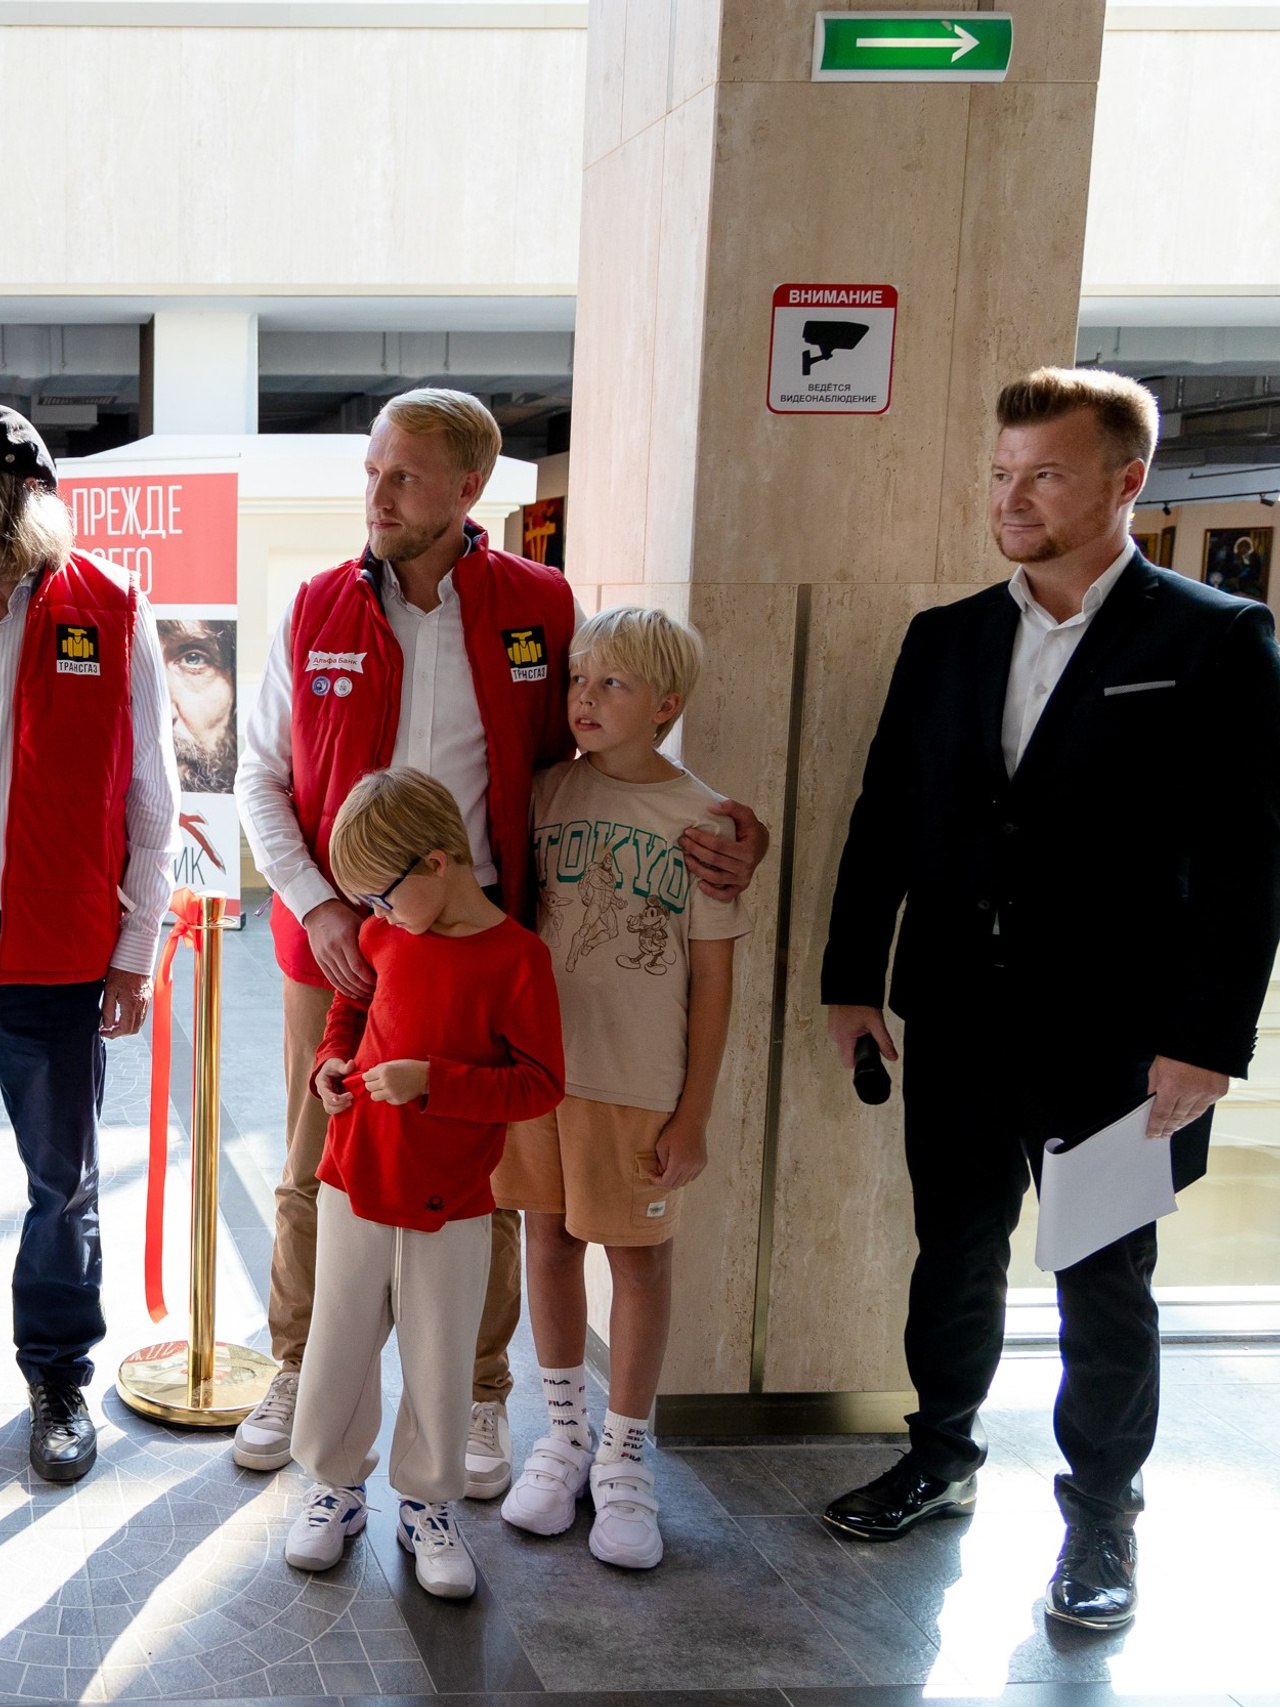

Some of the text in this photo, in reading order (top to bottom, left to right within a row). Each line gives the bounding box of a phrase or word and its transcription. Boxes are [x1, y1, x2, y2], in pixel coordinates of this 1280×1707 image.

[789, 290, 883, 304] ВНИМАНИЕ
[808, 383, 851, 392] ВЕДЁТСЯ
[780, 395, 877, 403] ВИДЕОНАБЛЮДЕНИЕ
[72, 485, 183, 540] ПРЕЖДЕ
[58, 661, 98, 673] ТРАНСГАЗ
[534, 820, 690, 914] TOKYO
[543, 1378, 571, 1386] FILA
